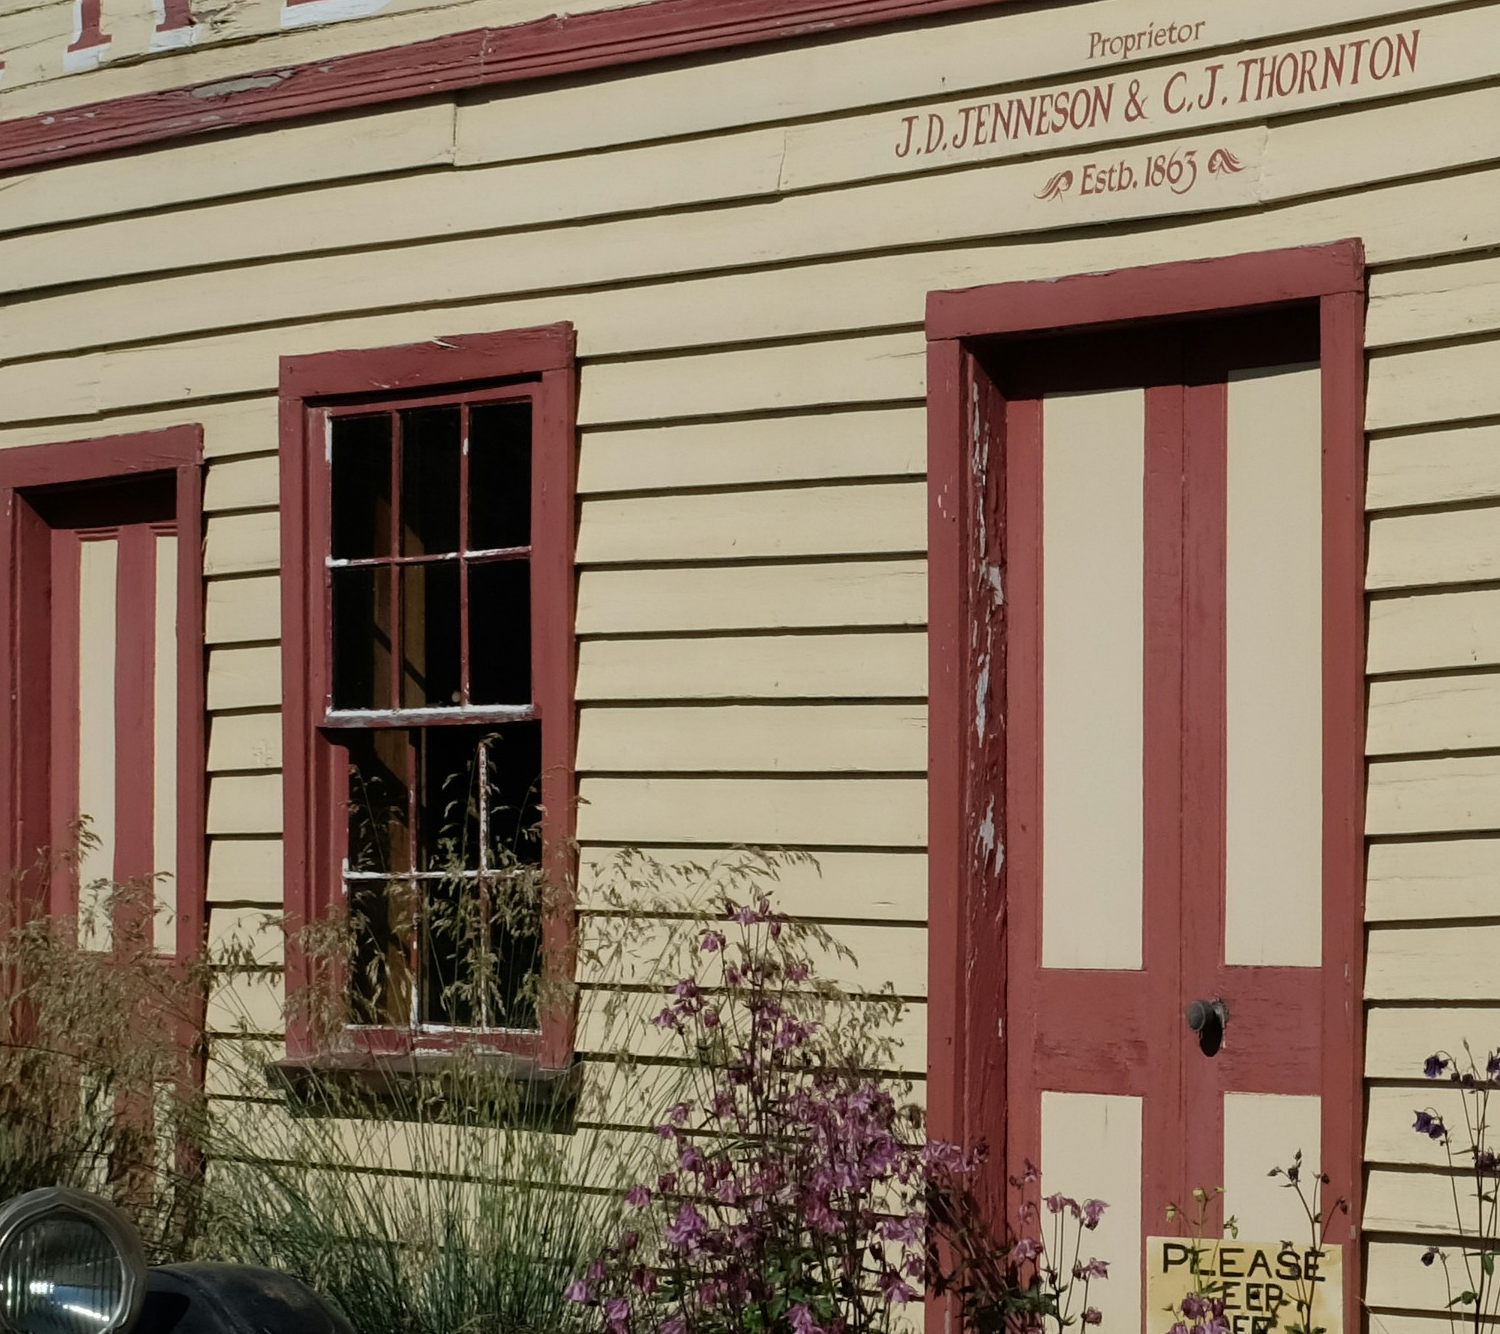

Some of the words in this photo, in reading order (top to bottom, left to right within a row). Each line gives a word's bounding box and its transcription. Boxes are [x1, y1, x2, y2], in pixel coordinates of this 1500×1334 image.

[1087, 20, 1205, 60] Proprietor
[1123, 79, 1150, 124] &
[1238, 28, 1422, 104] THORNTON
[1080, 160, 1138, 197] Estb.
[1144, 145, 1199, 195] 1863
[1162, 1242, 1326, 1282] PLEASE
